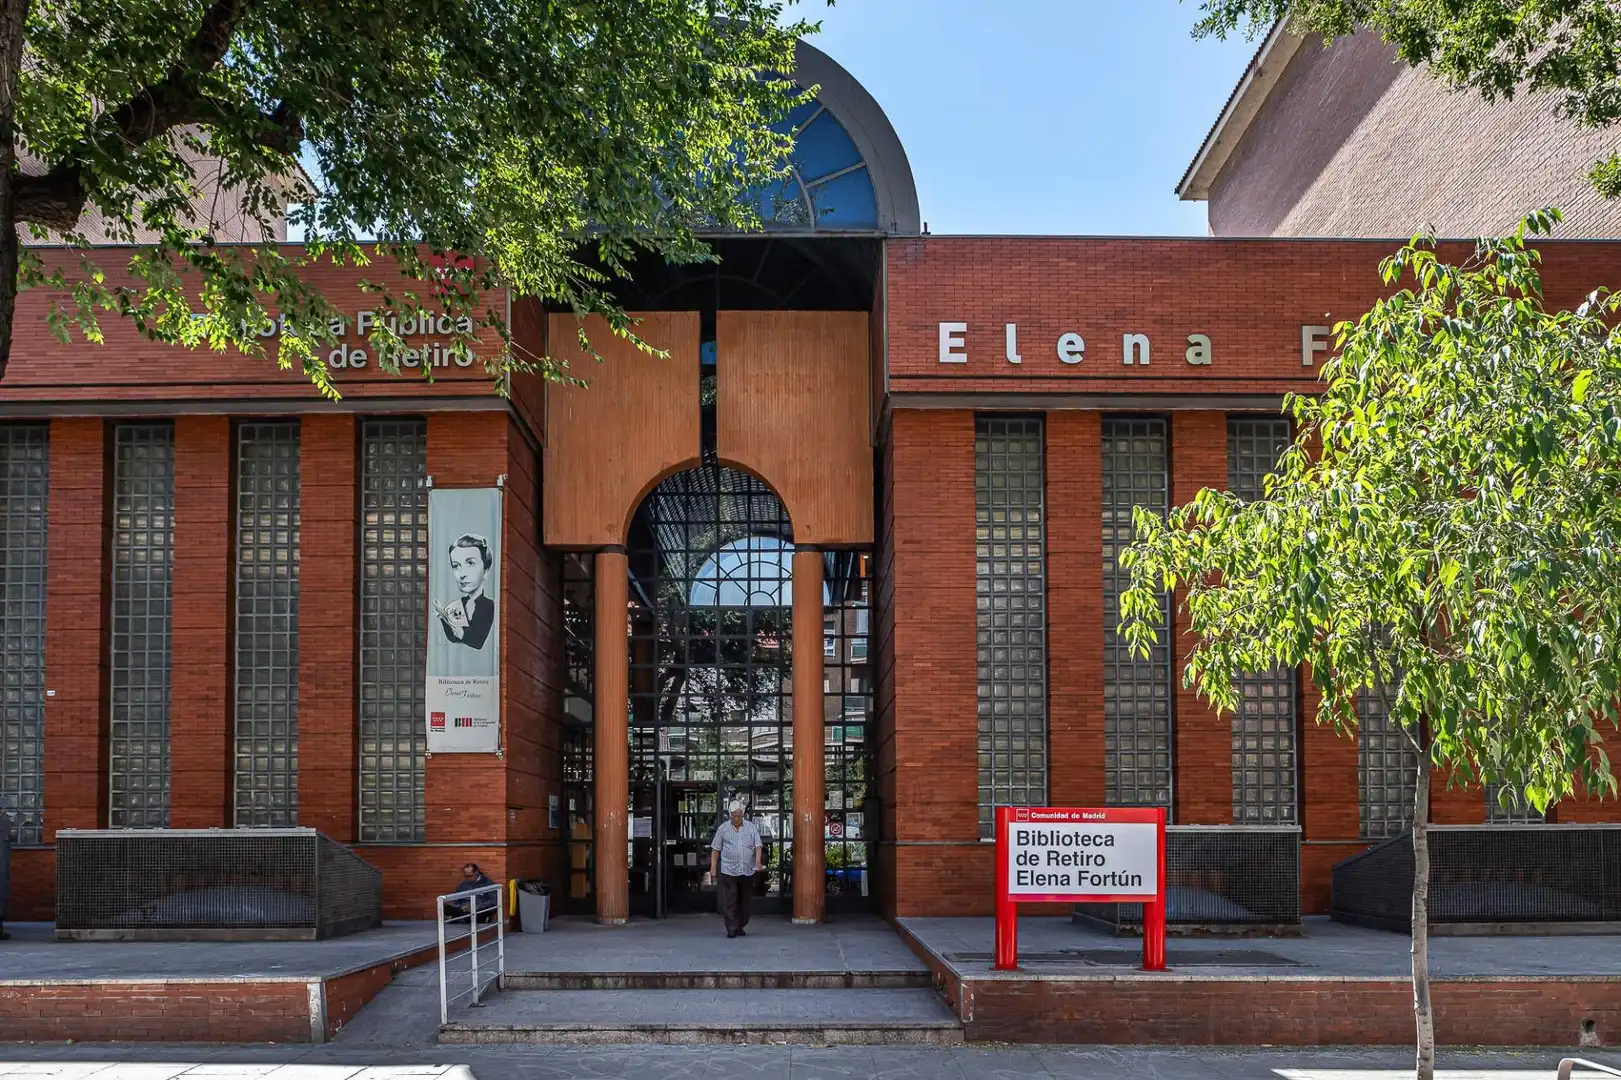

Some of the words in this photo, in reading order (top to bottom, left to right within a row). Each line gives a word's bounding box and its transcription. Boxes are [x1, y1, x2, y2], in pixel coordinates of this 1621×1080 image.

[938, 321, 1212, 364] Elena
[329, 343, 367, 368] de
[1031, 811, 1069, 819] Comunidad
[1016, 830, 1115, 847] Biblioteca
[1016, 850, 1039, 867] de
[1047, 850, 1106, 867] Retiro
[1016, 870, 1070, 886] Elena
[1078, 870, 1142, 887] Fortún
